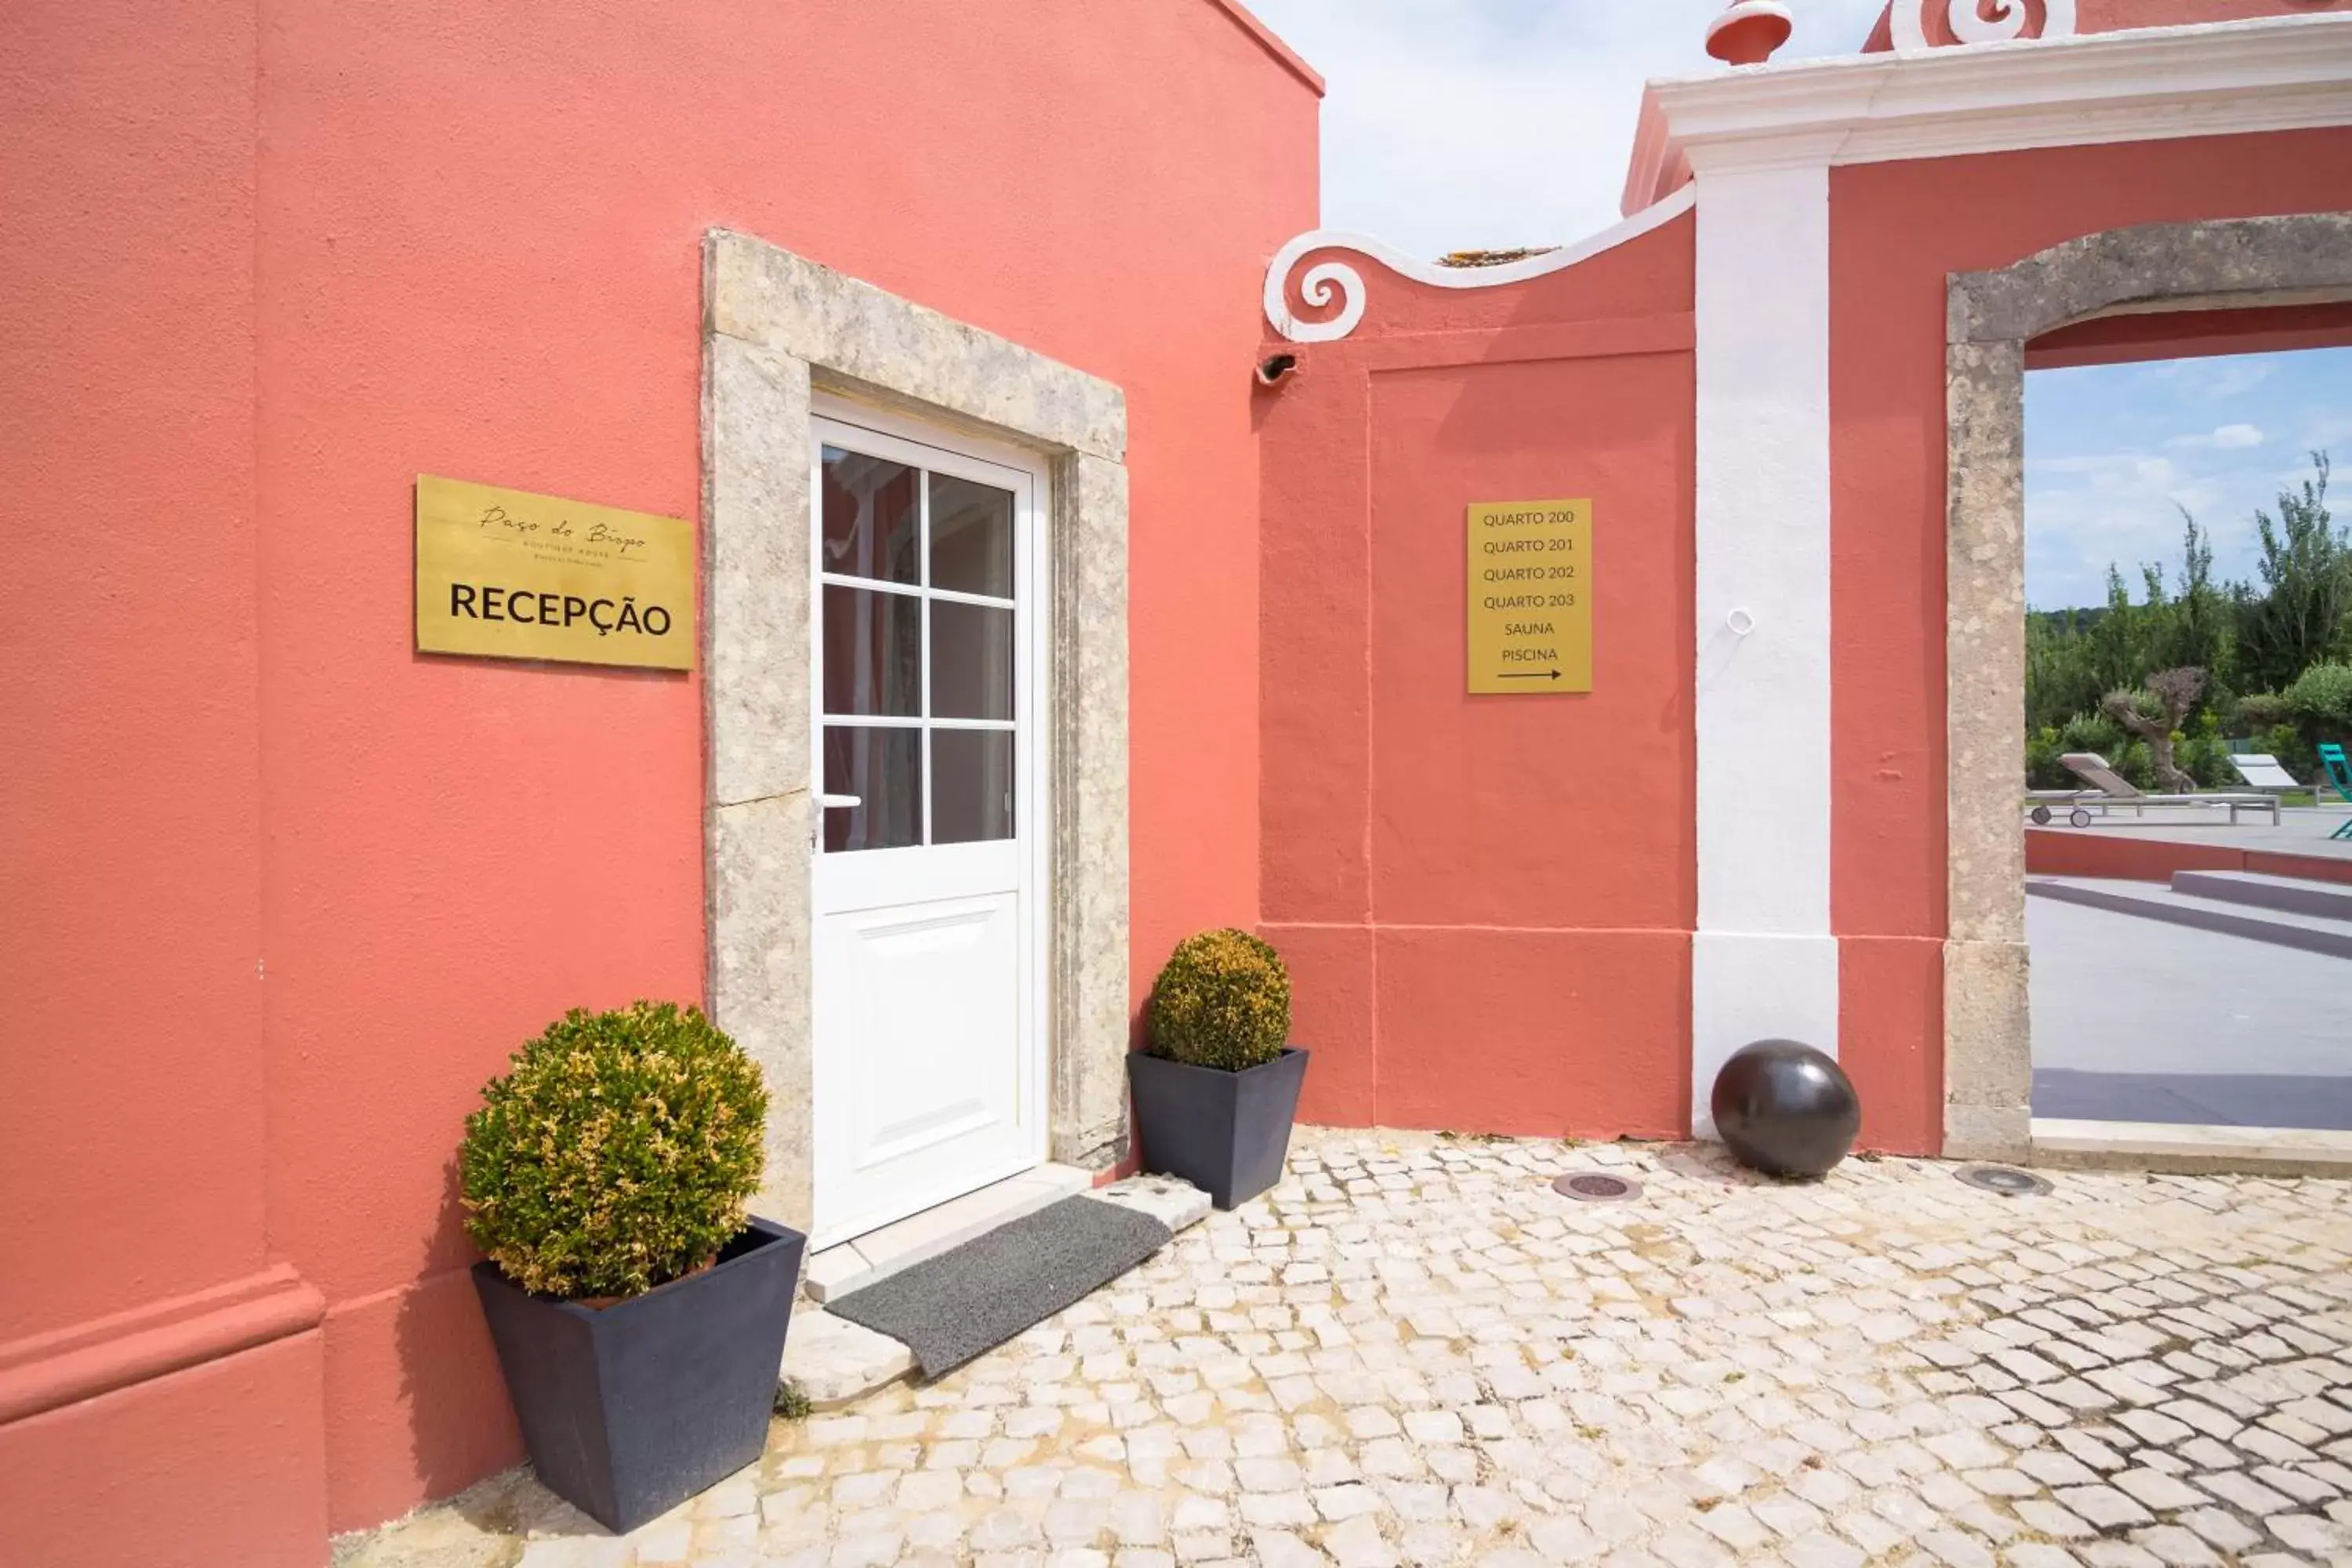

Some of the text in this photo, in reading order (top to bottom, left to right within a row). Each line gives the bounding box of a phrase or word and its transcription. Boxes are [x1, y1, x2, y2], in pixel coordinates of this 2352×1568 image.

[1483, 510, 1574, 527] QUARTO 200
[552, 520, 574, 536] do
[1484, 539, 1573, 554] QUARTO 201
[1484, 565, 1574, 582] QUARTO 202
[1484, 593, 1574, 609] QUARTO 203
[451, 583, 671, 636] RECEPÇÃO
[1504, 622, 1555, 636] SAUNA
[1502, 649, 1559, 662] PISCINA
